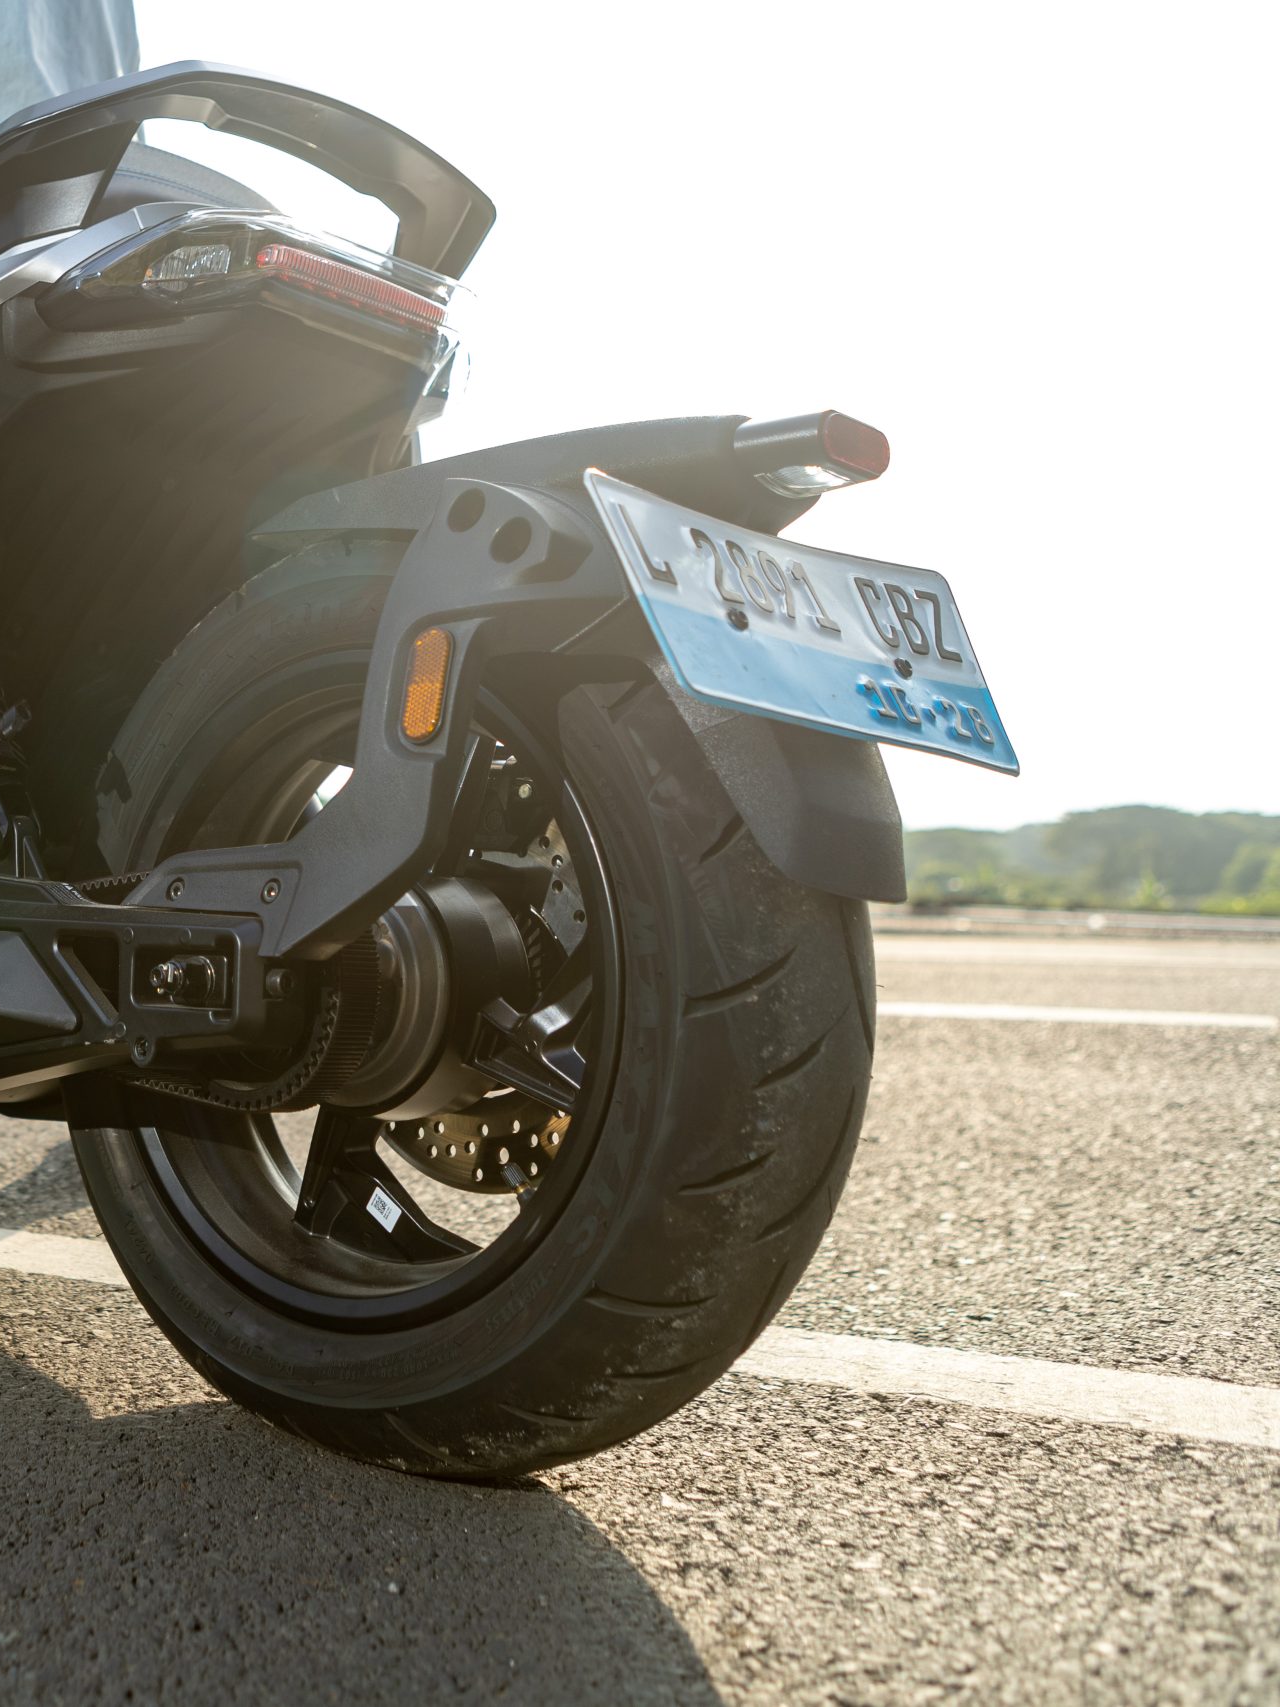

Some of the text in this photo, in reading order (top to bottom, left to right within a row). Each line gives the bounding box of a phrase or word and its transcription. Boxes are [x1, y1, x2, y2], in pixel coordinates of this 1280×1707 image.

[618, 503, 963, 663] L 2891 CBZ
